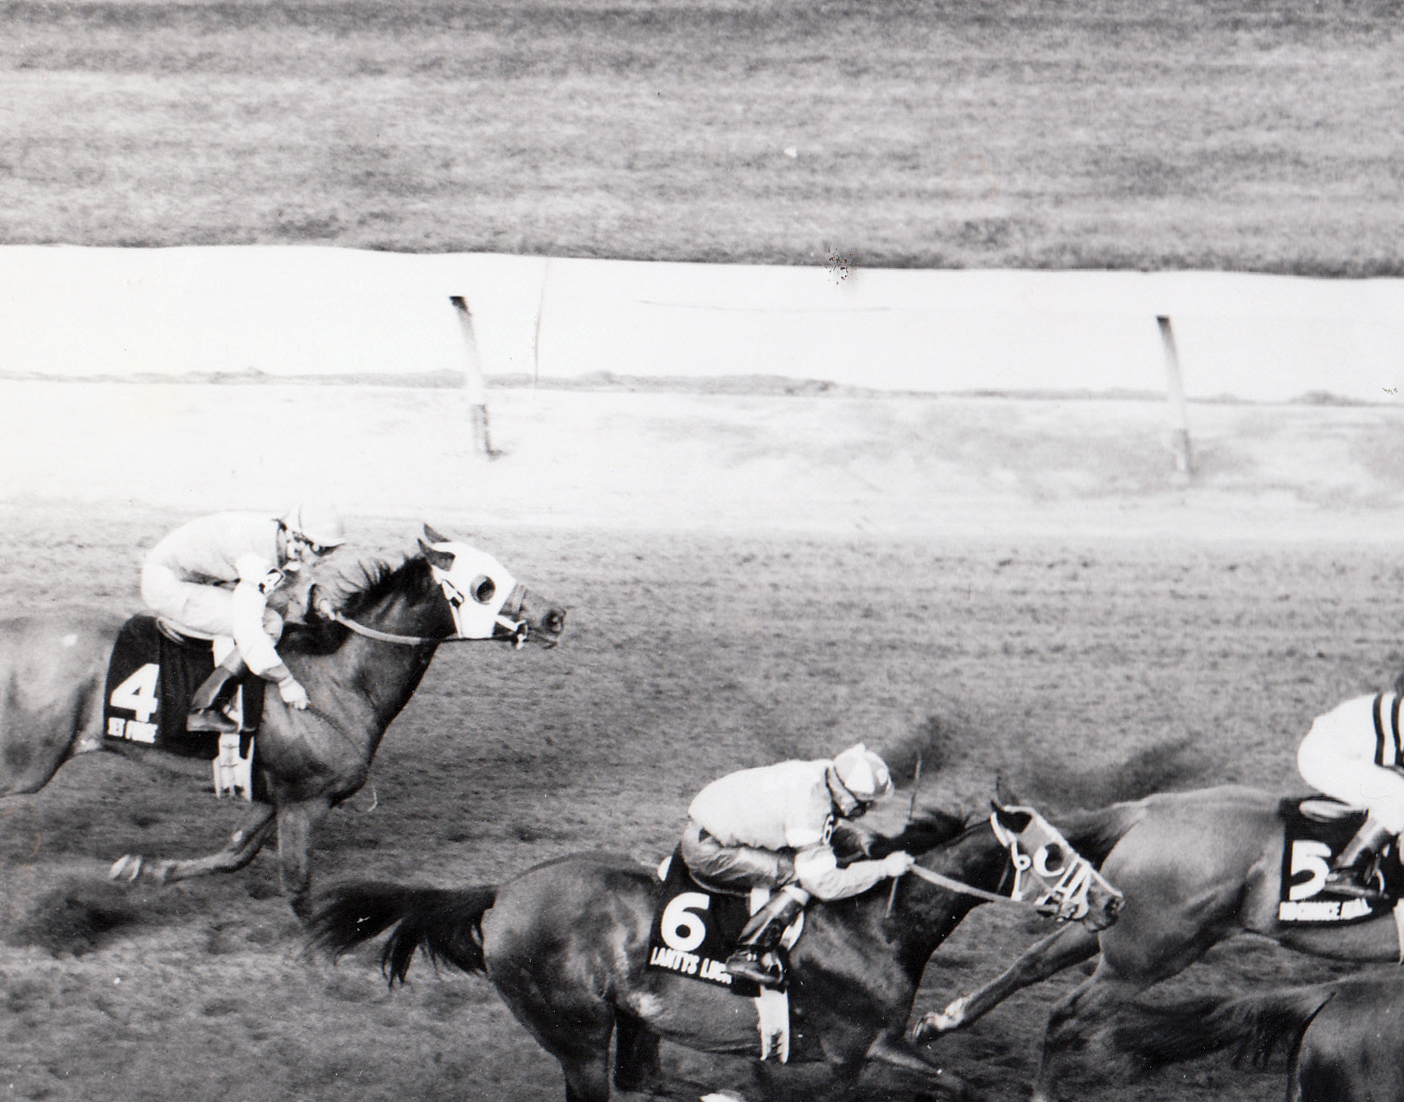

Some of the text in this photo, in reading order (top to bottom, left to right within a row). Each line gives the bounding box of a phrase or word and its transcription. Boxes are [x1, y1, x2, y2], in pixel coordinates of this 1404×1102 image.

[110, 663, 160, 723] 4
[823, 814, 834, 845] 6
[1011, 842, 1031, 871] 6
[1289, 839, 1333, 901] 5
[660, 892, 711, 952] 6
